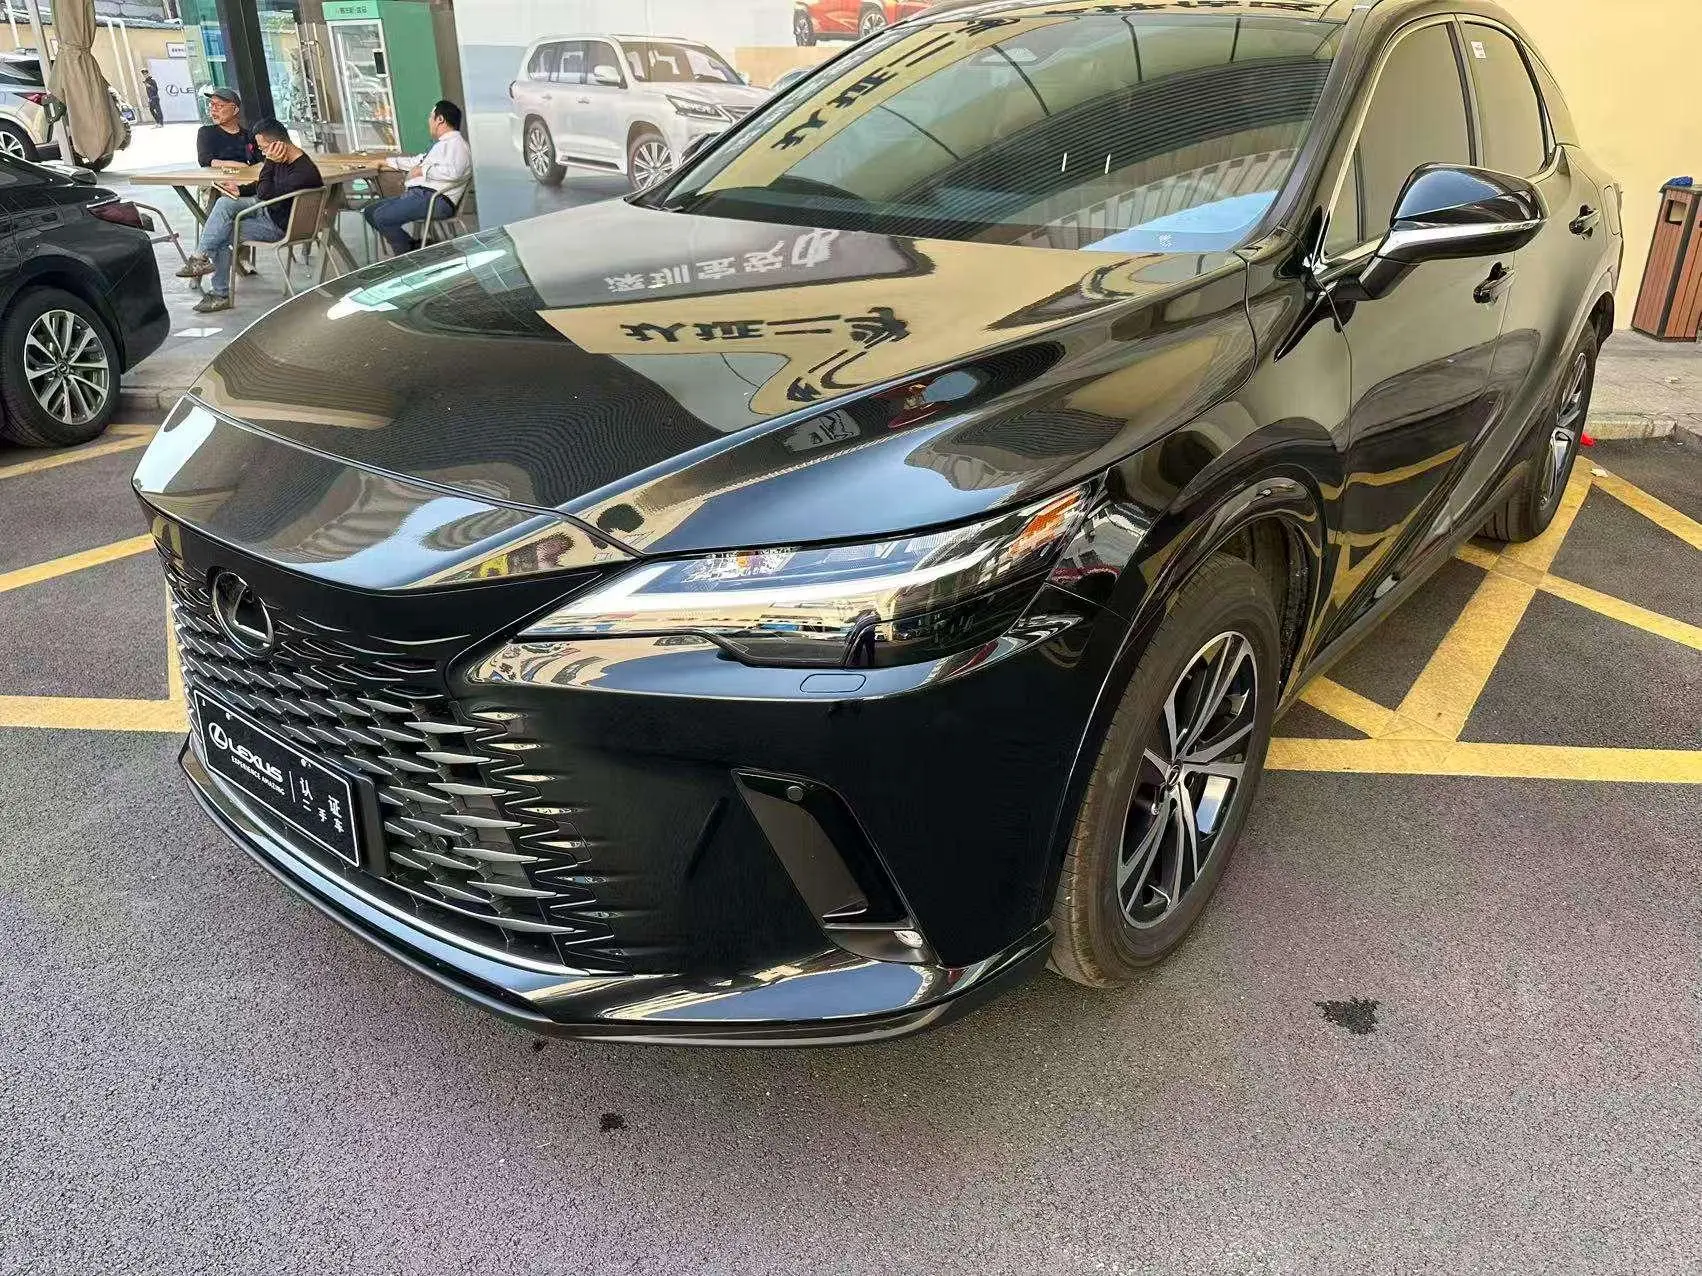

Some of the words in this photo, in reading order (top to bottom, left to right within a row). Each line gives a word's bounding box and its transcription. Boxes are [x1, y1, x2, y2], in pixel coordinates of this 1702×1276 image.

[228, 737, 284, 783] LEXUS
[231, 755, 261, 780] EXPERIENCE
[261, 776, 286, 796] AMAZING
